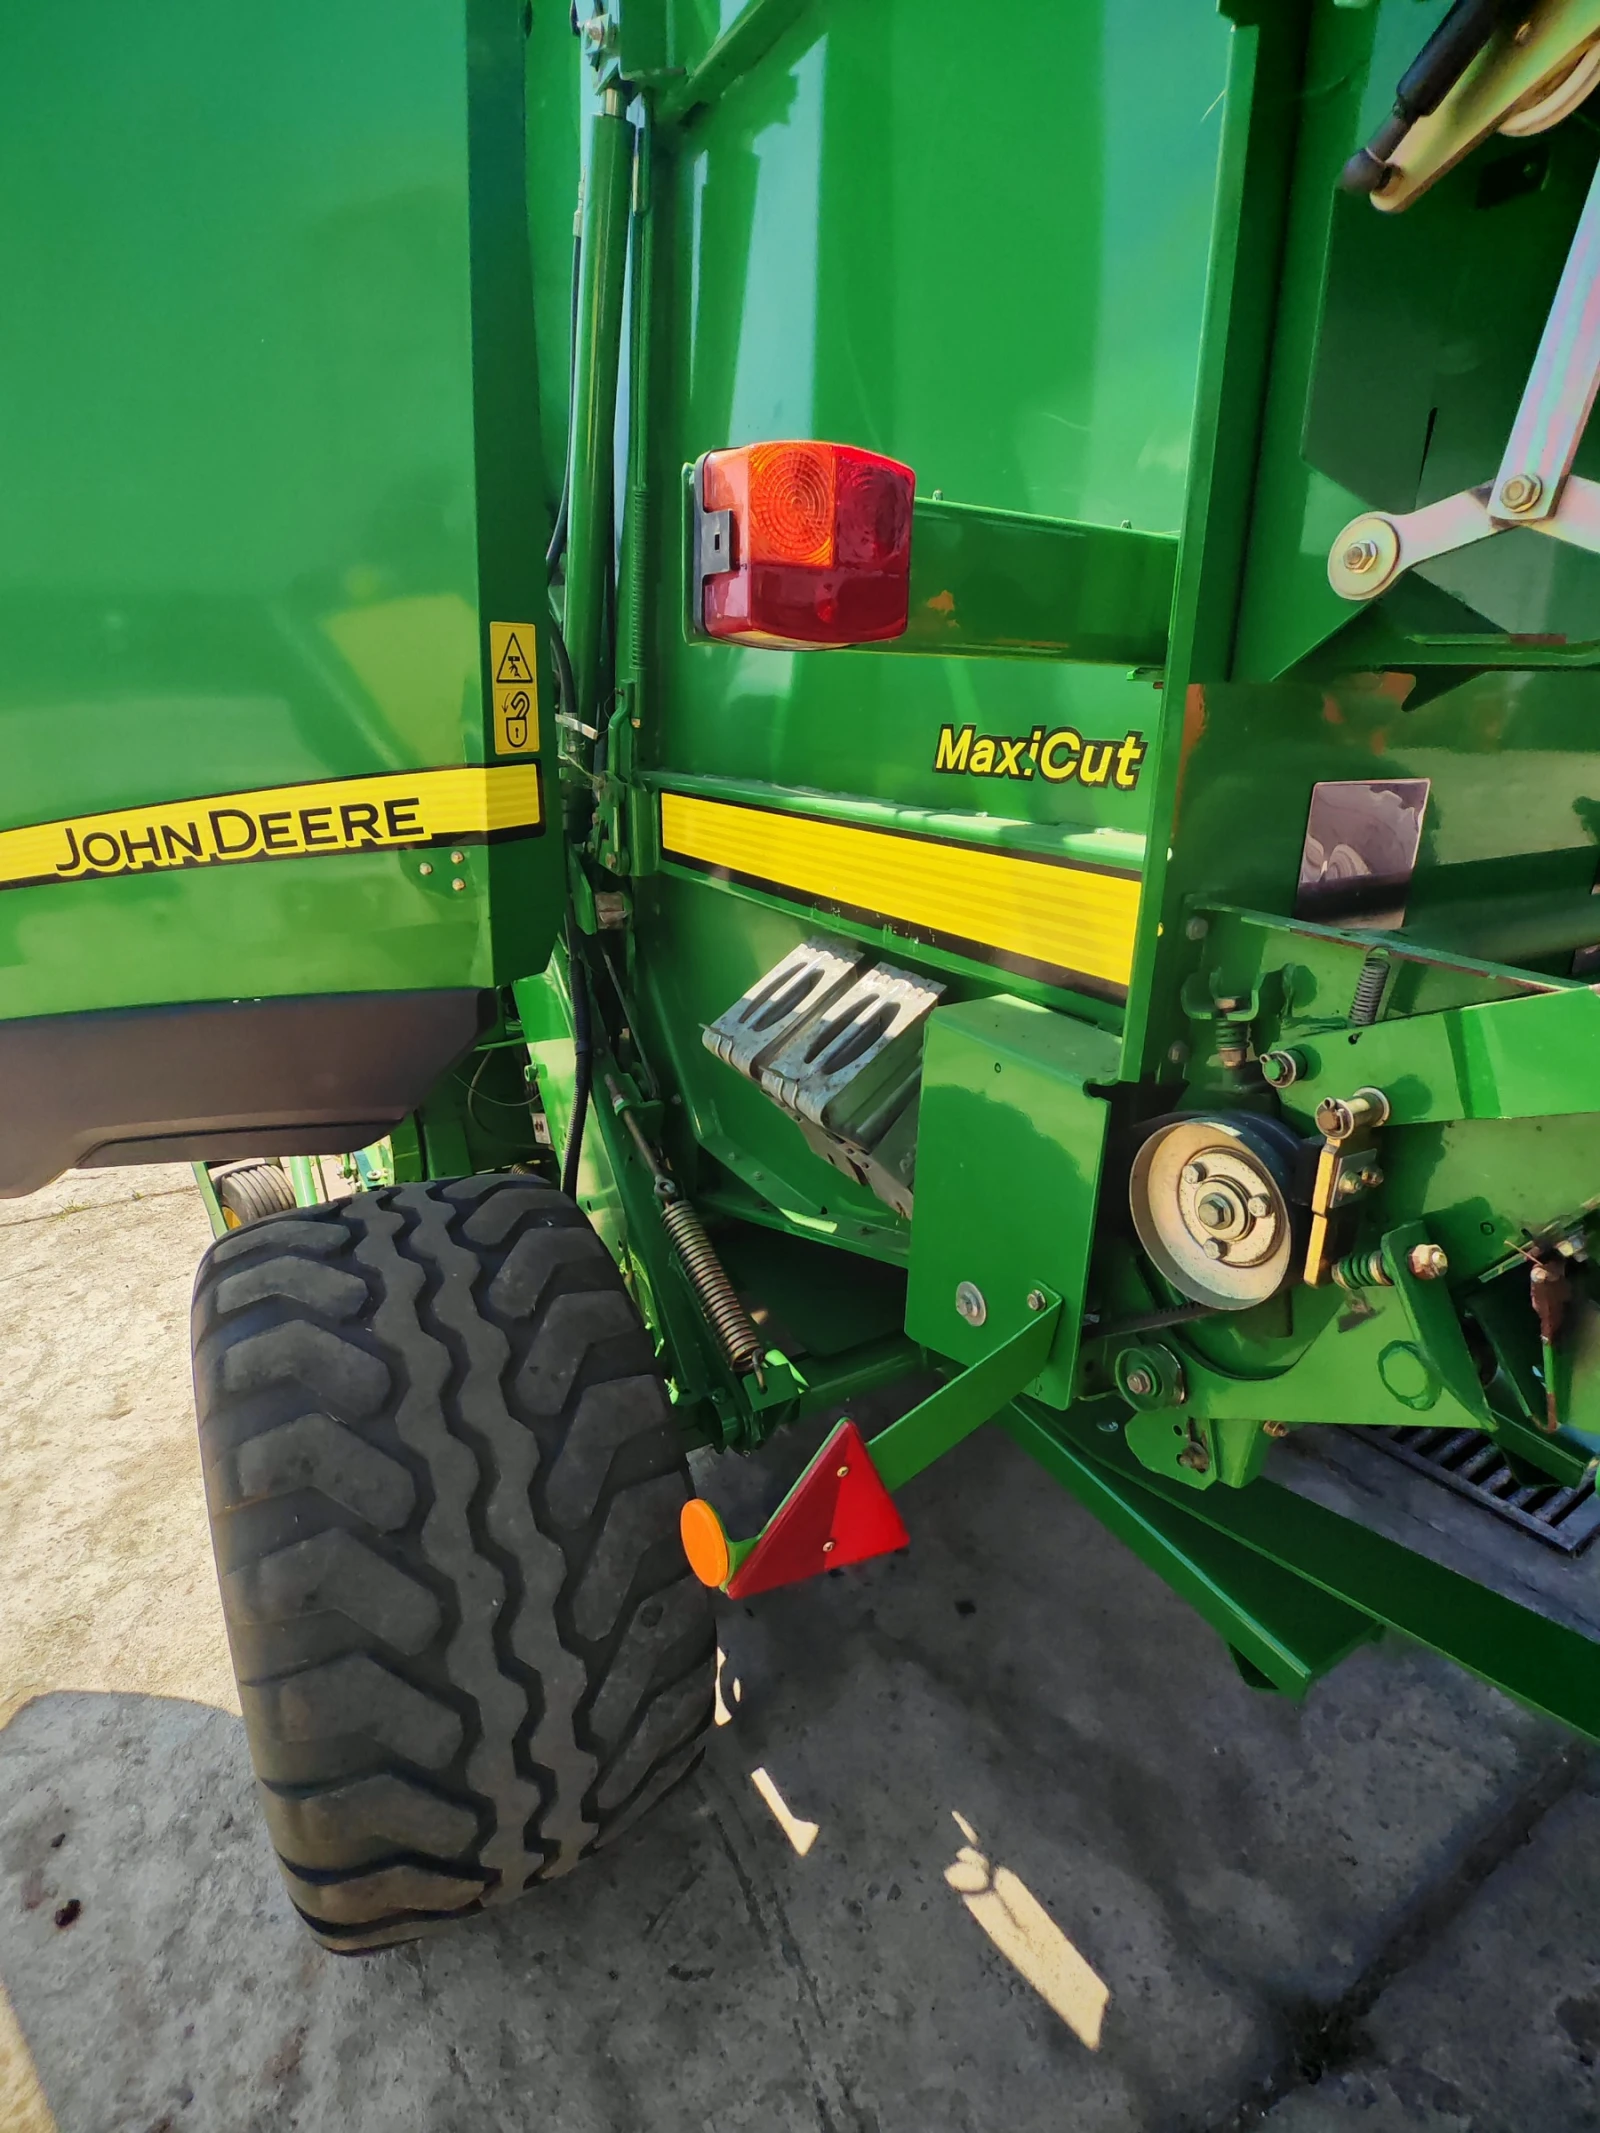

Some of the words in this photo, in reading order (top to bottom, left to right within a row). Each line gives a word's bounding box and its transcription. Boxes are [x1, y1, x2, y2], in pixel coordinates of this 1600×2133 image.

[934, 726, 1144, 788] MaxiCut
[55, 822, 202, 872] JOHN
[208, 797, 425, 854] DEERE
